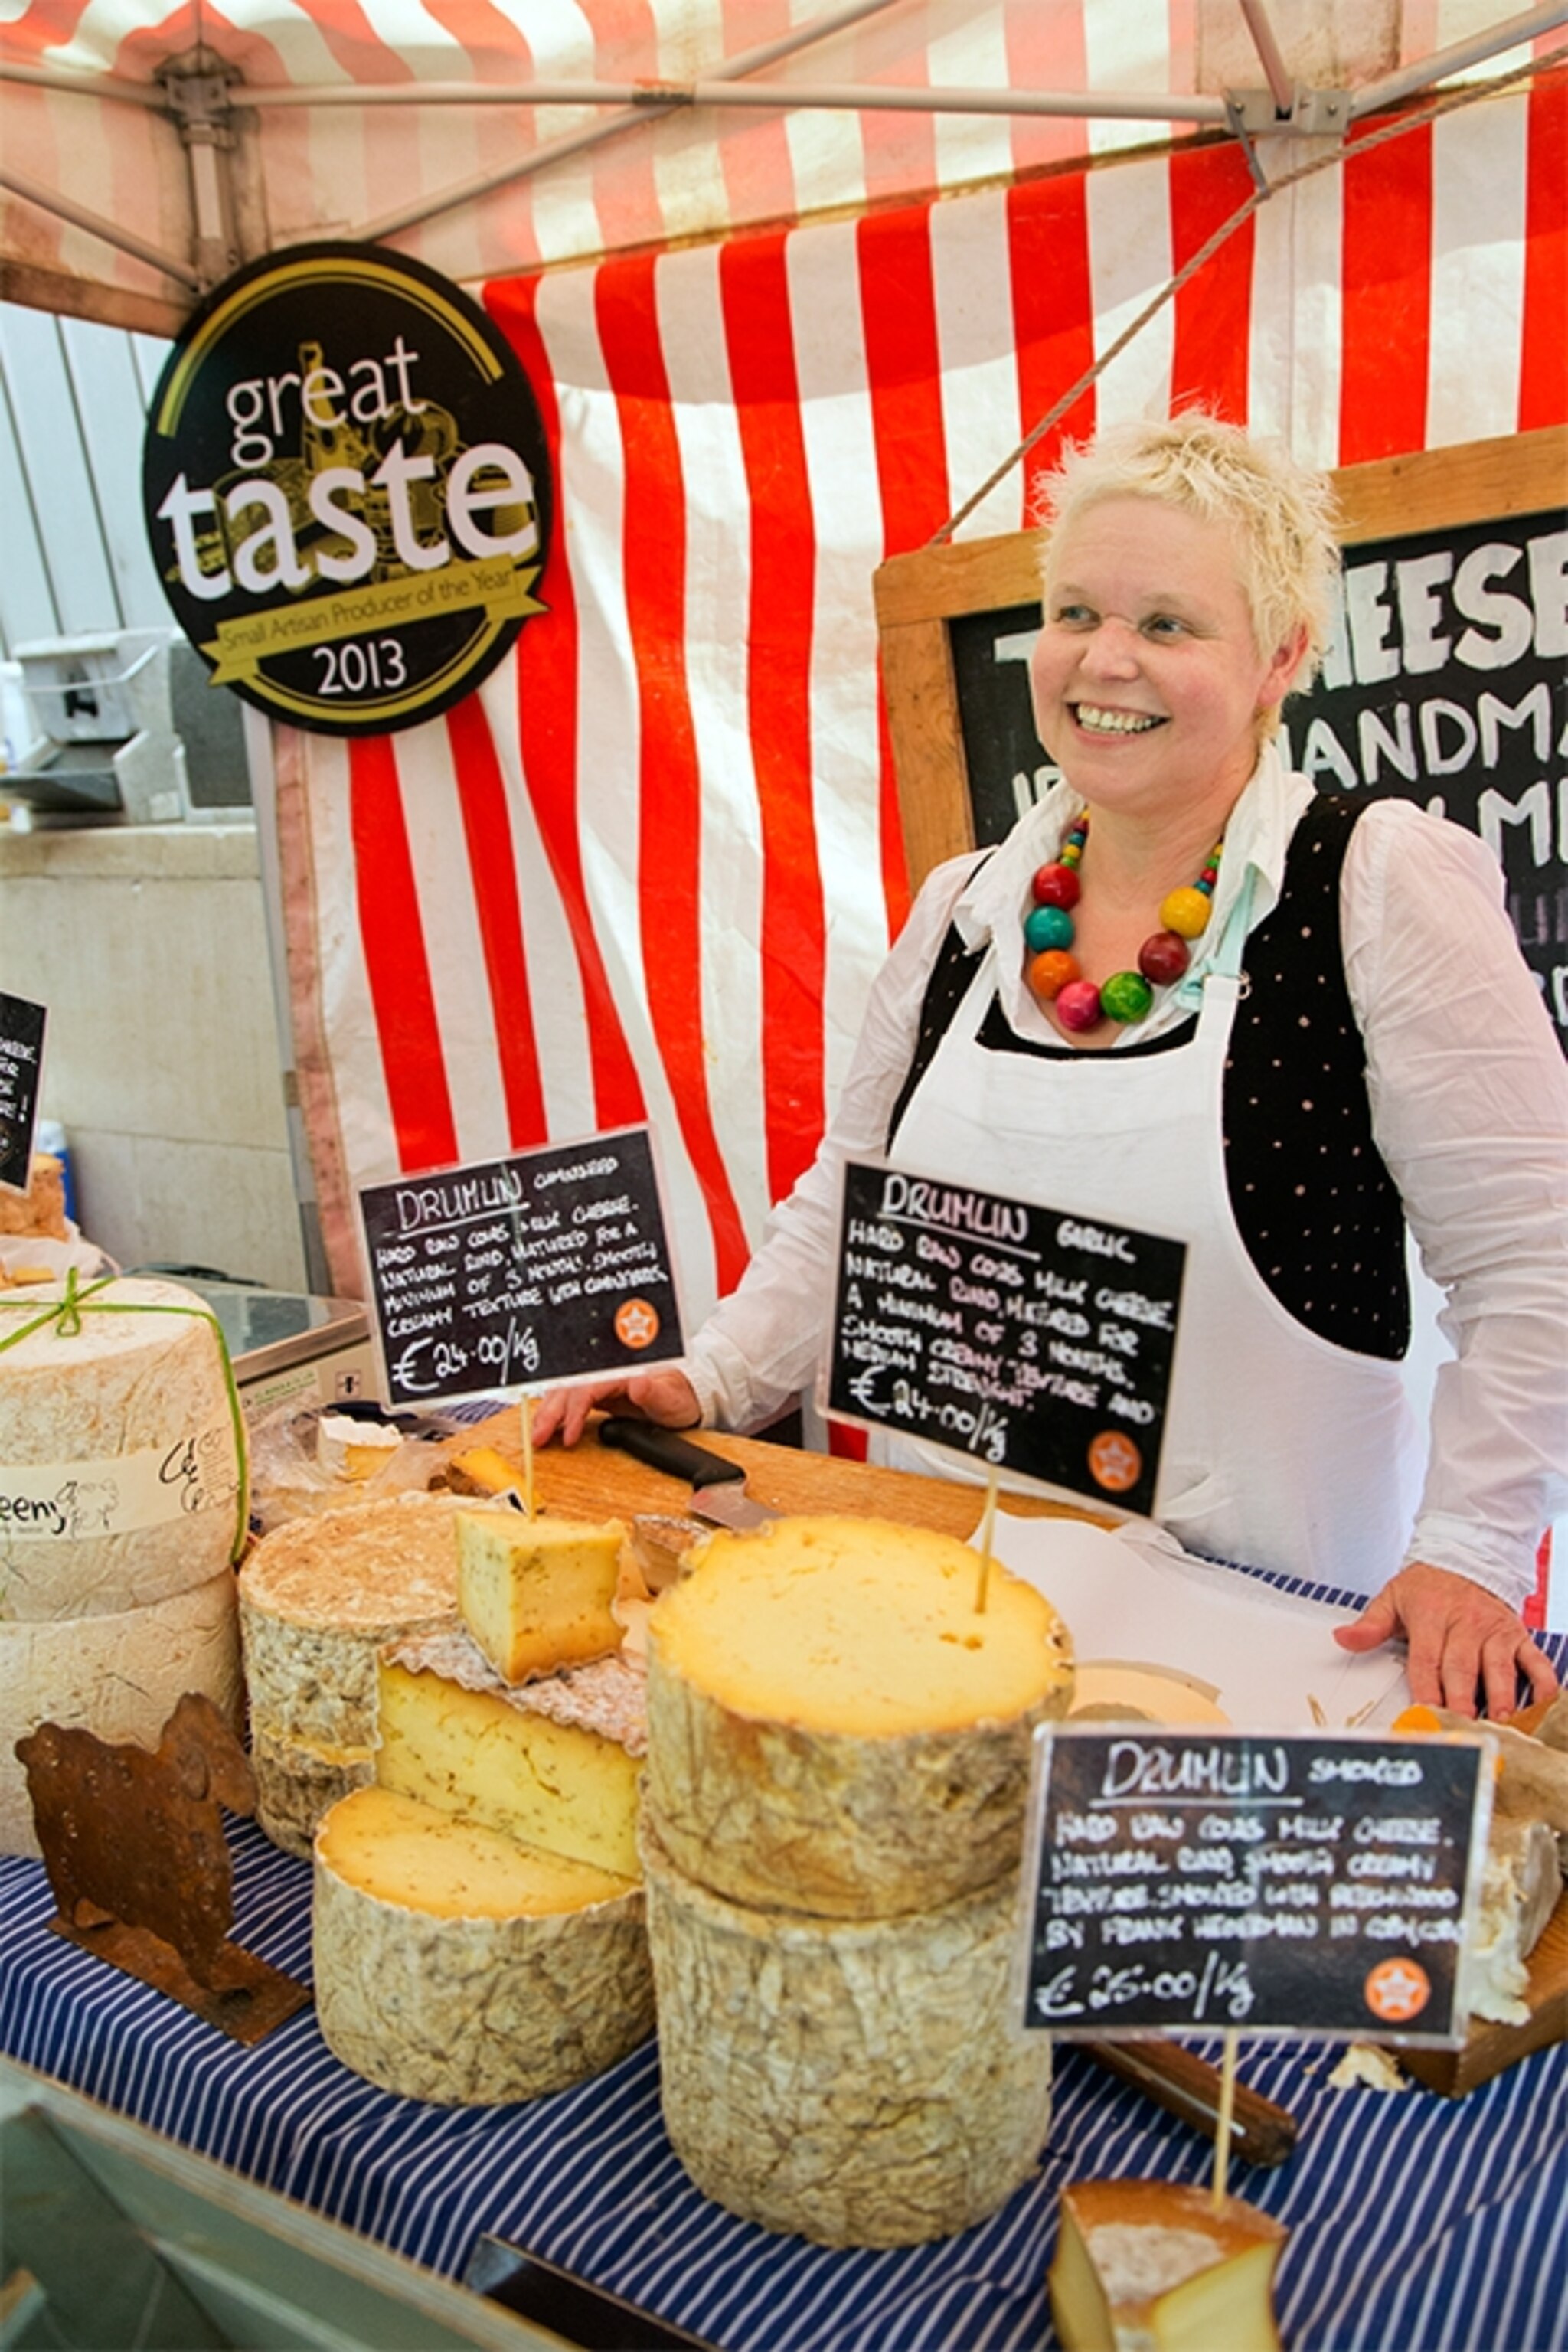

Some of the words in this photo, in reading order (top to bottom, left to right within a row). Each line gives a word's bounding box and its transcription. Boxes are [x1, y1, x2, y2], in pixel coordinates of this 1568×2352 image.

[227, 335, 427, 469] great
[157, 437, 538, 601] taste
[223, 625, 266, 651] Small
[270, 609, 328, 640] Artisan
[332, 593, 410, 623] Producer
[416, 583, 436, 604] of
[439, 577, 469, 600] the
[471, 570, 512, 594] Year
[312, 638, 407, 694] 2013
[1276, 681, 1568, 790] ANDM
[396, 1170, 523, 1230] DRUMLIN
[881, 1174, 1027, 1241] DRUMLIN
[1057, 1220, 1136, 1263] GARLIC
[376, 1246, 416, 1269] HARD
[425, 1235, 459, 1256] RAW
[467, 1223, 511, 1248] COWS
[518, 1210, 561, 1233] MILK
[380, 1263, 457, 1292] NATURAL
[511, 1230, 588, 1259] MATURED
[596, 1225, 622, 1246] FOR
[625, 1221, 639, 1237] A
[848, 1219, 905, 1252] HARD
[916, 1234, 962, 1270] RAW
[970, 1253, 1024, 1287] COWS
[1035, 1271, 1088, 1305] MILK
[384, 1282, 456, 1315] MINIMUM
[467, 1272, 492, 1295] OF
[593, 1242, 657, 1272] SMOOTH
[387, 1306, 453, 1338] CREAMY
[462, 1287, 543, 1318] TEXTURE
[549, 1280, 582, 1306] WITH
[846, 1251, 937, 1291] NATURAL
[1006, 1295, 1090, 1338] MATURED
[1098, 1323, 1139, 1357] FOR
[847, 1282, 862, 1309] A
[877, 1291, 962, 1334] MINIMUM
[975, 1321, 1005, 1344] OF
[1018, 1330, 1037, 1357] 3
[841, 1315, 922, 1353] SMOOTH
[929, 1338, 1004, 1378] CREAMY
[1007, 1359, 1100, 1408] TEXTURE
[1108, 1392, 1155, 1425] AND
[842, 1340, 916, 1372] MEDIUM
[1102, 1741, 1289, 1798] DRUMLIN
[1308, 1756, 1423, 1785] SMOKED
[1055, 1811, 1118, 1847] HARD
[1130, 1812, 1186, 1841] RAW
[1198, 1812, 1266, 1842] COWS
[1277, 1815, 1344, 1841] MILK
[1051, 1847, 1170, 1883] NATURAL
[1243, 1847, 1335, 1876] SMOOTH
[1348, 1851, 1438, 1881] CREAMY
[1158, 1880, 1258, 1909] SMOKED
[1265, 1883, 1319, 1907] WITH
[1046, 1917, 1084, 1950] BY
[1101, 1914, 1184, 1945] FRANK
[1331, 1913, 1359, 1939] IN
